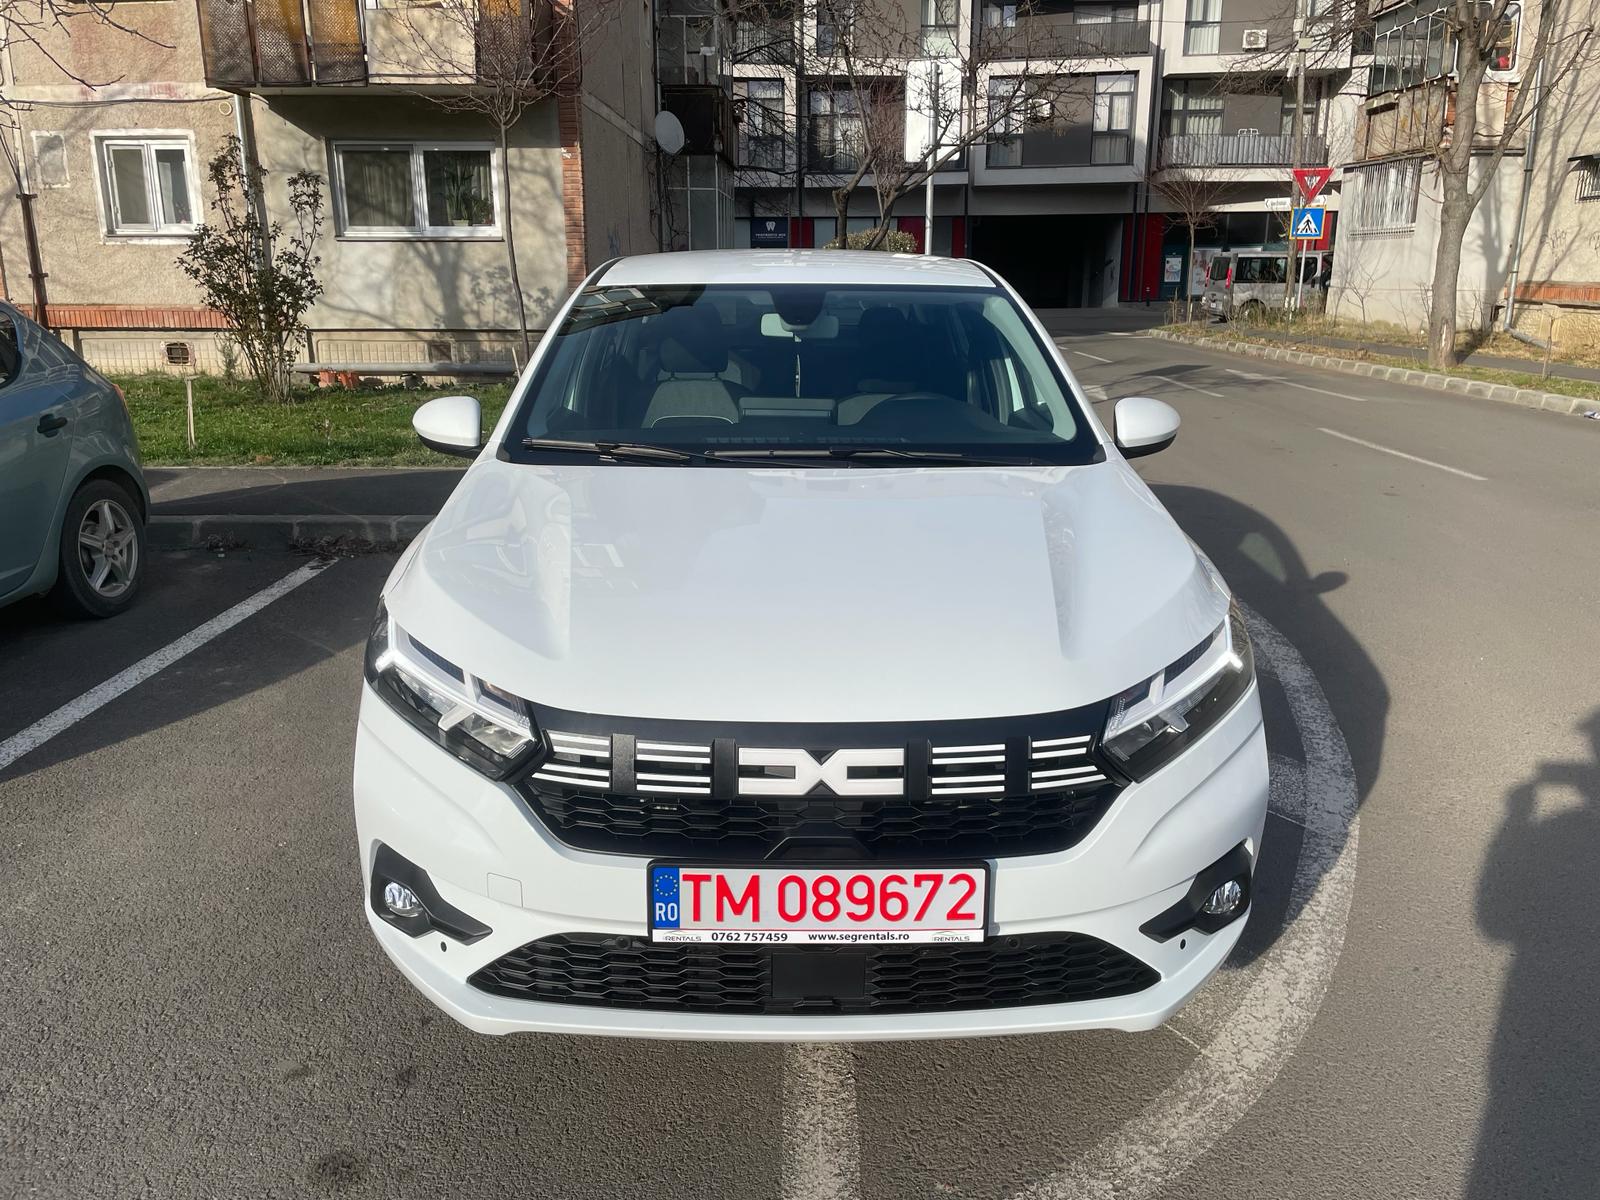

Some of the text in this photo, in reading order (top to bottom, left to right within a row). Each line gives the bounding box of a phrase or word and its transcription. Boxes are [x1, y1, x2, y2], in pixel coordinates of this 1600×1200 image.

[682, 873, 977, 923] TM 089672
[655, 902, 678, 921] RO
[711, 932, 788, 942] 0762 757459
[808, 931, 910, 943] www.segrentals.ro
